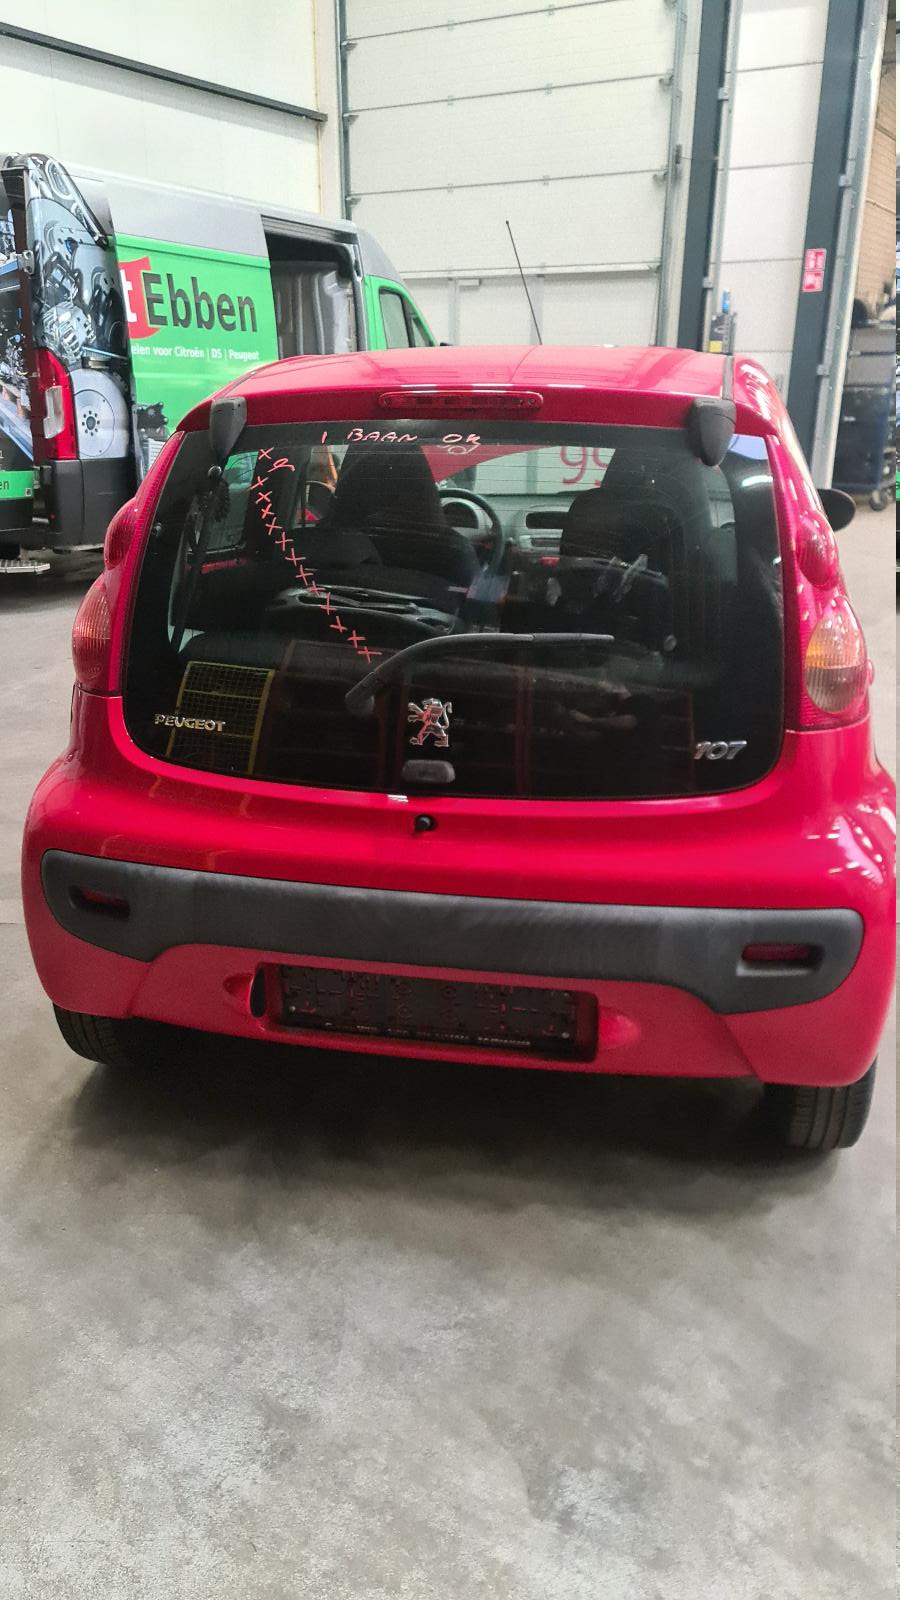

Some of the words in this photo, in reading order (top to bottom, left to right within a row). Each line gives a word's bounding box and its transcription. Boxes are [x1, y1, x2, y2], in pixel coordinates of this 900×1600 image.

[142, 271, 258, 333] Ebben
[153, 347, 173, 357] voor
[174, 345, 205, 359] Citroën
[211, 348, 223, 359] DS
[229, 349, 260, 363] Peugeot
[347, 427, 418, 443] BAAN
[154, 712, 226, 733] PEUGEOT
[694, 740, 748, 760] 107
